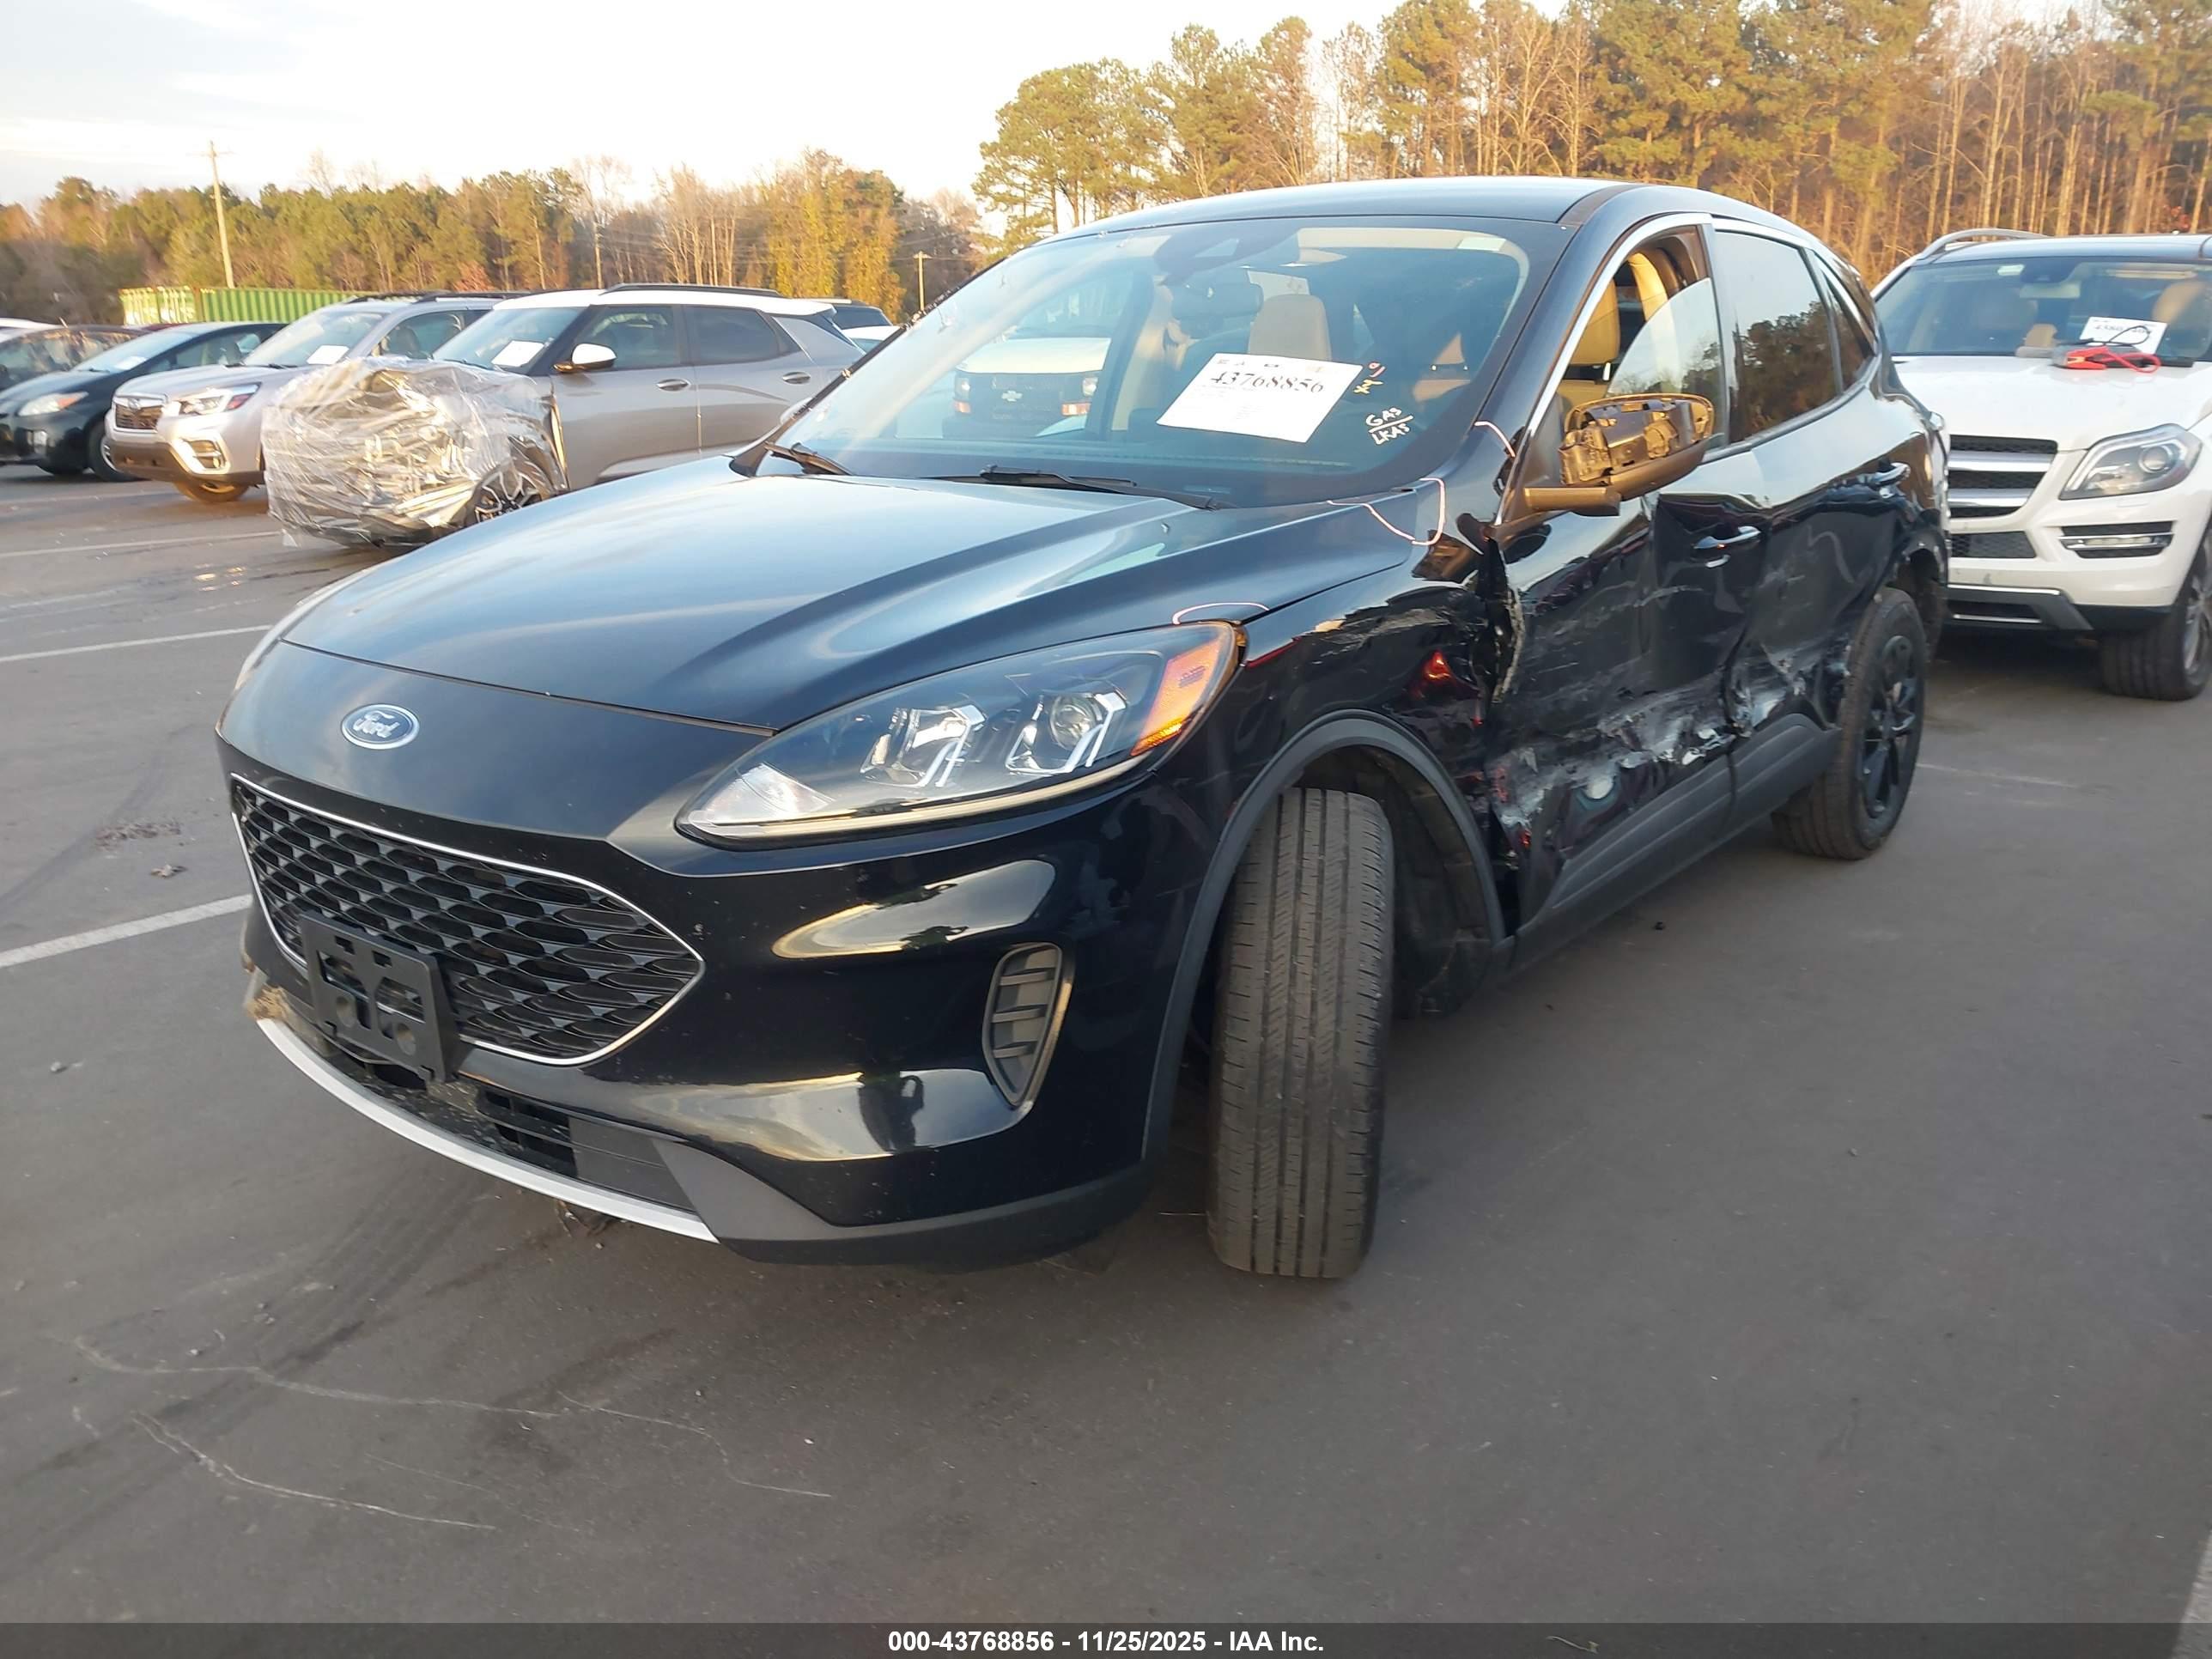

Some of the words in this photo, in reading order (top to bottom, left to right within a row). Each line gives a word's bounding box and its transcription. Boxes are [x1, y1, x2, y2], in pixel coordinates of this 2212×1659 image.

[1210, 370, 1325, 394] 43768856
[1365, 407, 1402, 427] GAS
[352, 710, 401, 738] Ford
